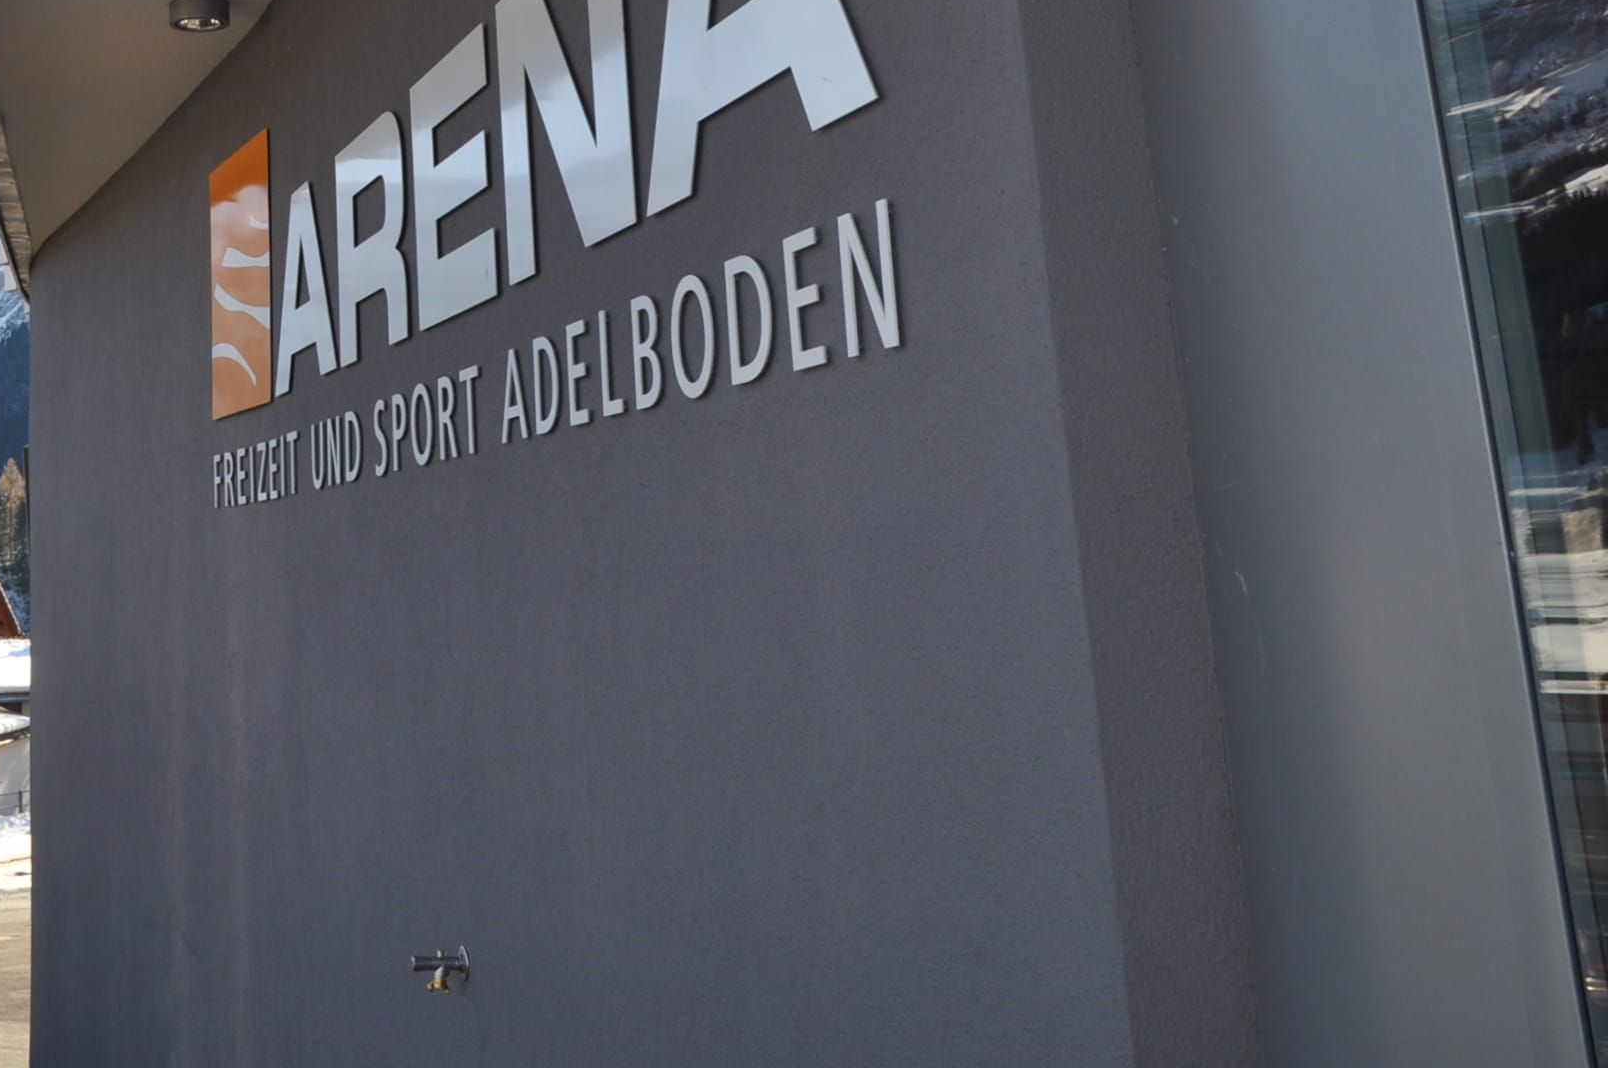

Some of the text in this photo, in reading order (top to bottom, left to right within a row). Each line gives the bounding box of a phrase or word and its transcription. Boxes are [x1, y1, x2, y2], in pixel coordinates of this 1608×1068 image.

[212, 197, 902, 509] FREIZEIT UND SPORT ADELBODEN
